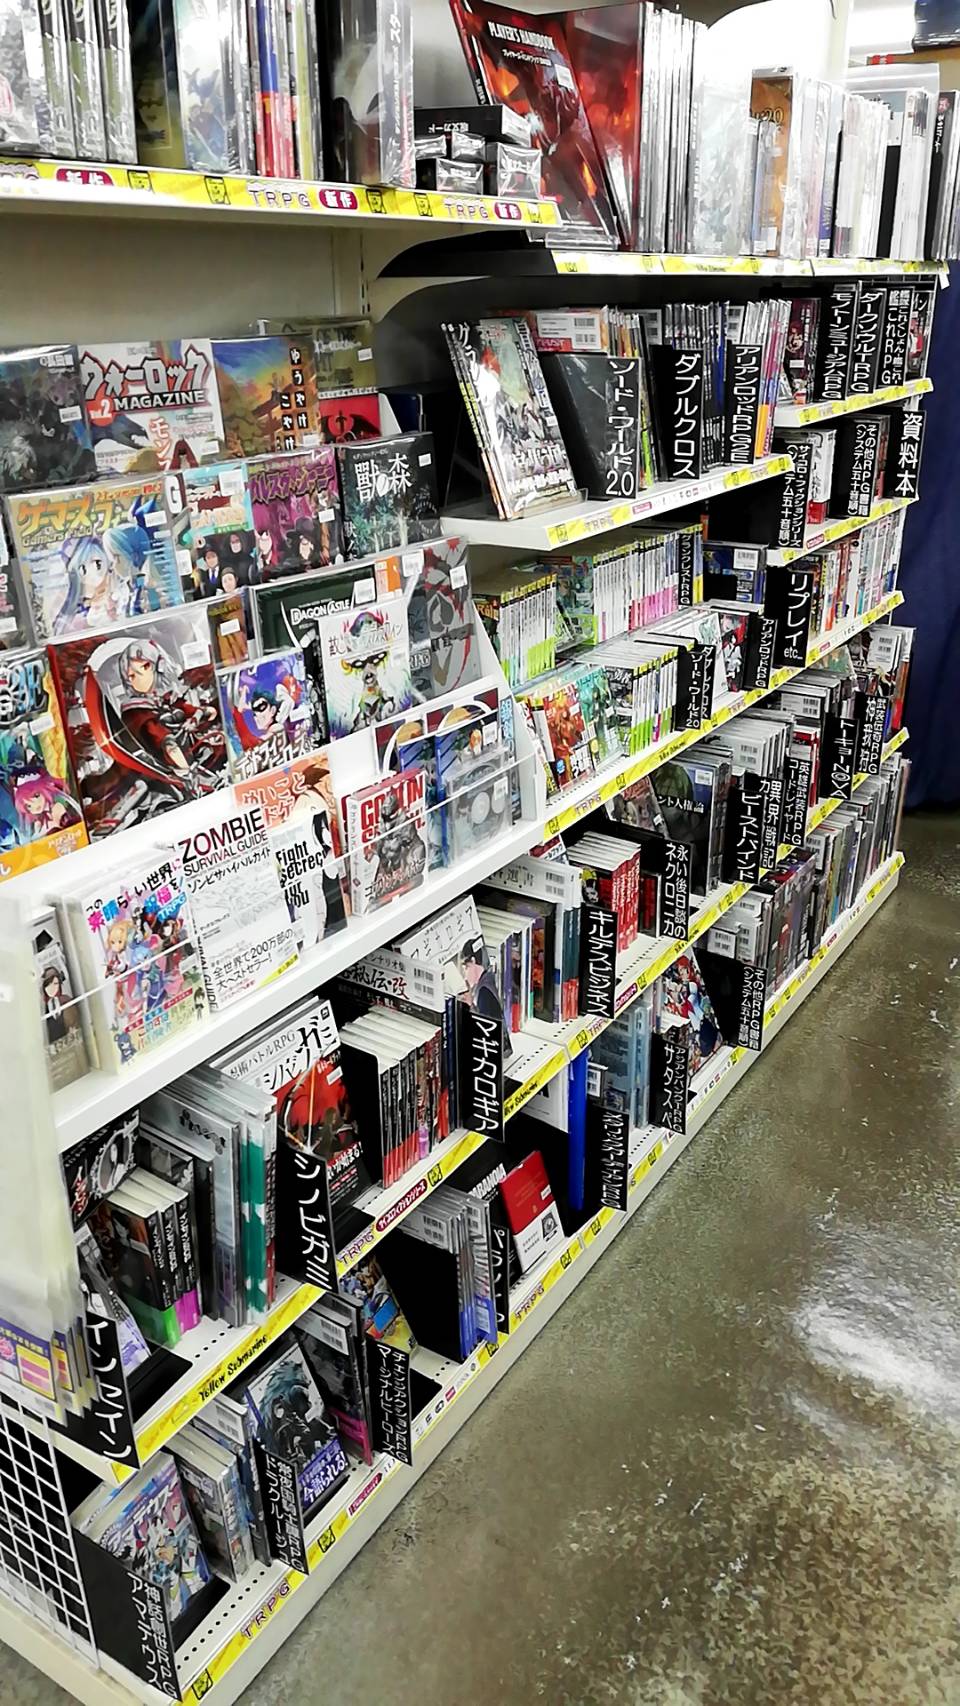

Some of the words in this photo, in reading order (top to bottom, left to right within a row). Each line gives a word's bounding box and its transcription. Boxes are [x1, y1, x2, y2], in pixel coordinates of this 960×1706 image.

[249, 190, 310, 208] TRPG
[445, 203, 489, 220] TRPG
[822, 292, 854, 399] モノトーンミュージアムRPG
[850, 291, 883, 393] ダークソウルTRPG
[881, 290, 900, 385] 艦これRPG
[114, 390, 206, 412] MAGAZINE
[290, 347, 308, 429] ゆうやけ
[606, 361, 636, 497] ソード・ワールド2.0
[673, 353, 701, 478] ダブルクロス
[730, 345, 760, 463] アリアンロッドRPG2E
[894, 412, 924, 497] 資料本
[327, 599, 351, 615] CASTLE
[680, 534, 693, 606] グランクレストRPG
[785, 573, 811, 647] リプレイ
[701, 645, 716, 718] ダブルクロス
[755, 618, 775, 688] アリアンロッドRPG
[178, 808, 266, 864] ZOMBIE
[184, 848, 237, 876] SURVIVAL
[237, 830, 269, 852] GUIDE
[275, 839, 310, 866] Fight
[737, 791, 759, 881] ビーストバインド
[663, 842, 677, 936] ネクロニカ
[675, 845, 690, 939] 永い後日談の
[587, 910, 614, 1017] キルデスビジネス
[470, 1015, 500, 1132] マギカロギア
[663, 1045, 675, 1130] サタスペ
[296, 1152, 333, 1290] シノビガミ
[340, 1231, 375, 1266] TRPG
[515, 1283, 545, 1322] TRPG
[86, 1320, 133, 1460] インセイン
[226, 1334, 269, 1376] Submarine
[265, 1453, 291, 1565] ドラクルージュ
[127, 1571, 162, 1690] アマデウス
[241, 1581, 291, 1640] TRPG
